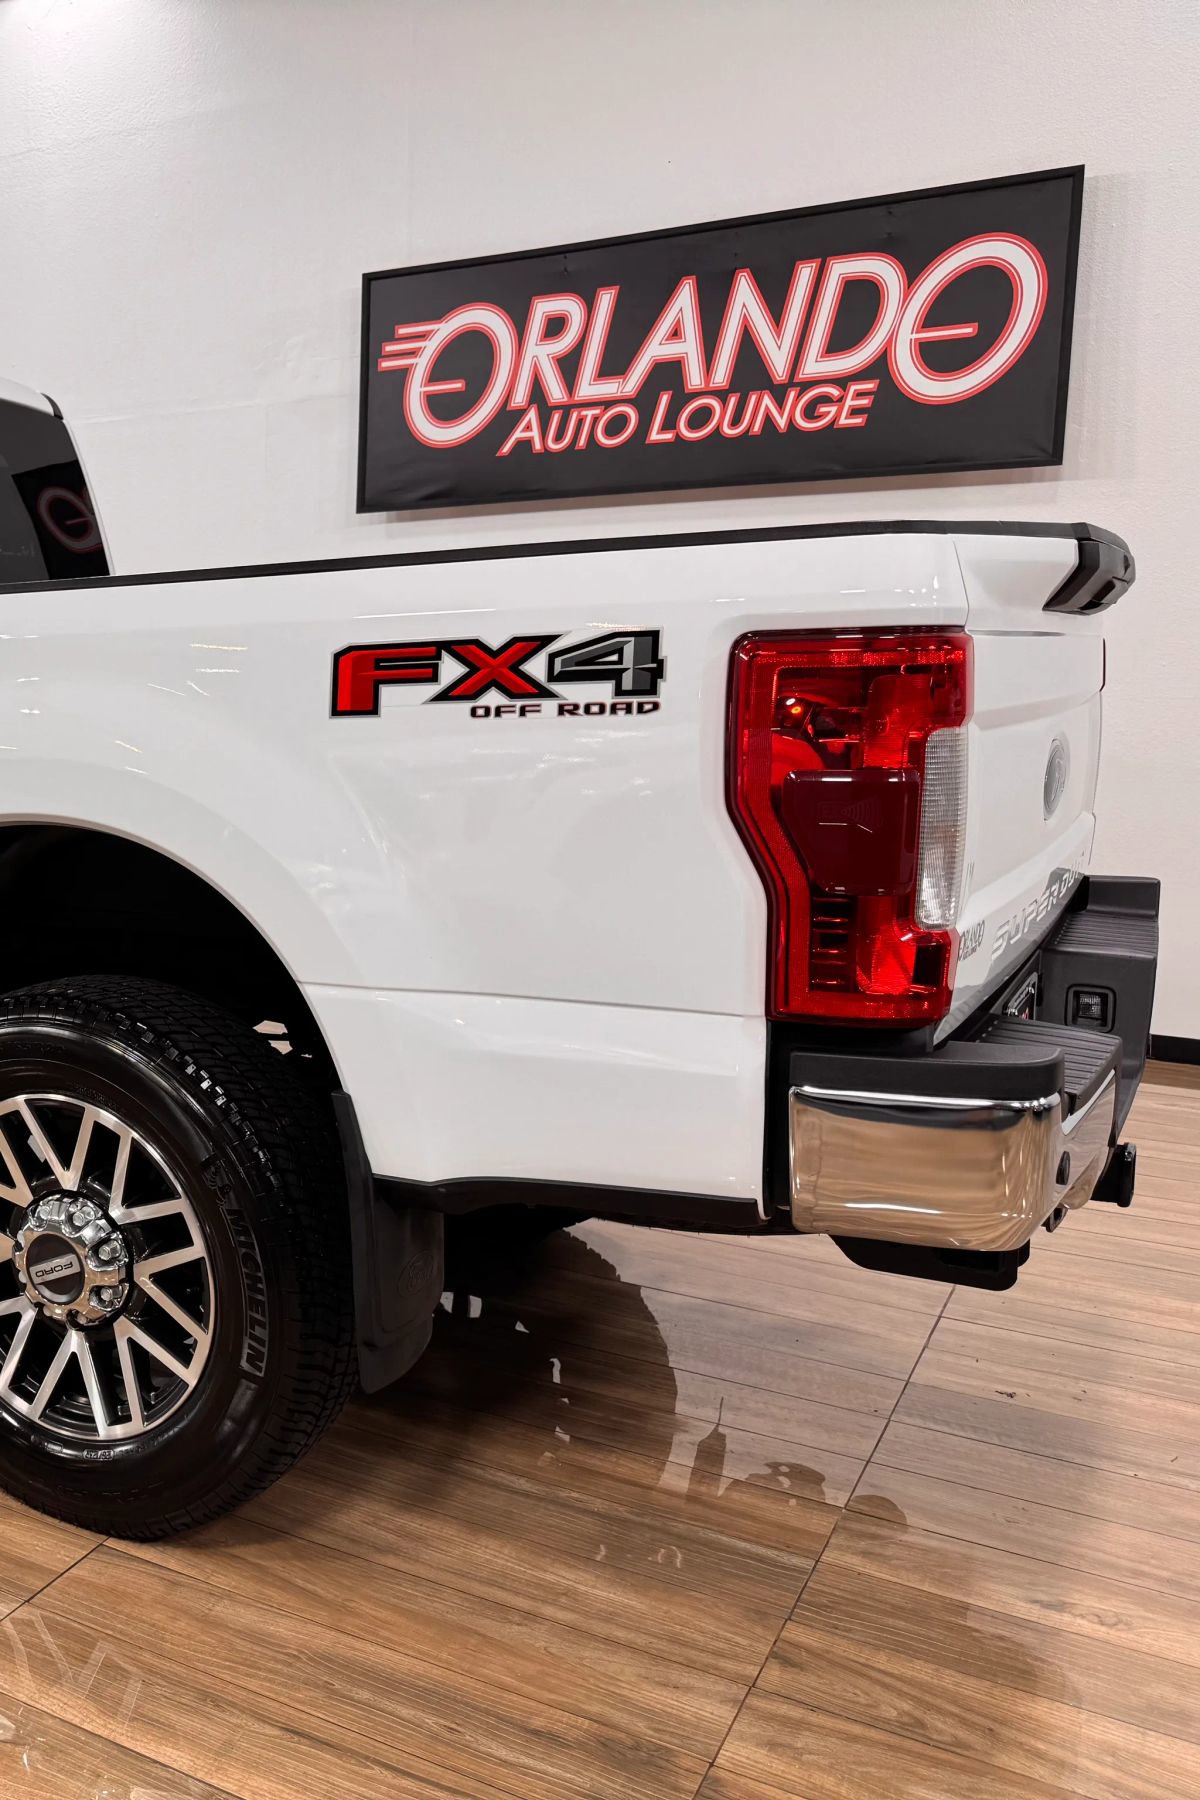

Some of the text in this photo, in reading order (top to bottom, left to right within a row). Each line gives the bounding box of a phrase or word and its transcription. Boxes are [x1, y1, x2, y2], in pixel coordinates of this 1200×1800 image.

[378, 232, 1049, 449] ORLANDO
[496, 379, 880, 457] AUTO LOUNGE
[329, 626, 667, 719] FX4
[469, 700, 661, 718] OFF ROAD
[991, 880, 1060, 960] SUPER
[35, 1261, 74, 1278] FORD
[225, 1208, 268, 1377] MICHELIN
